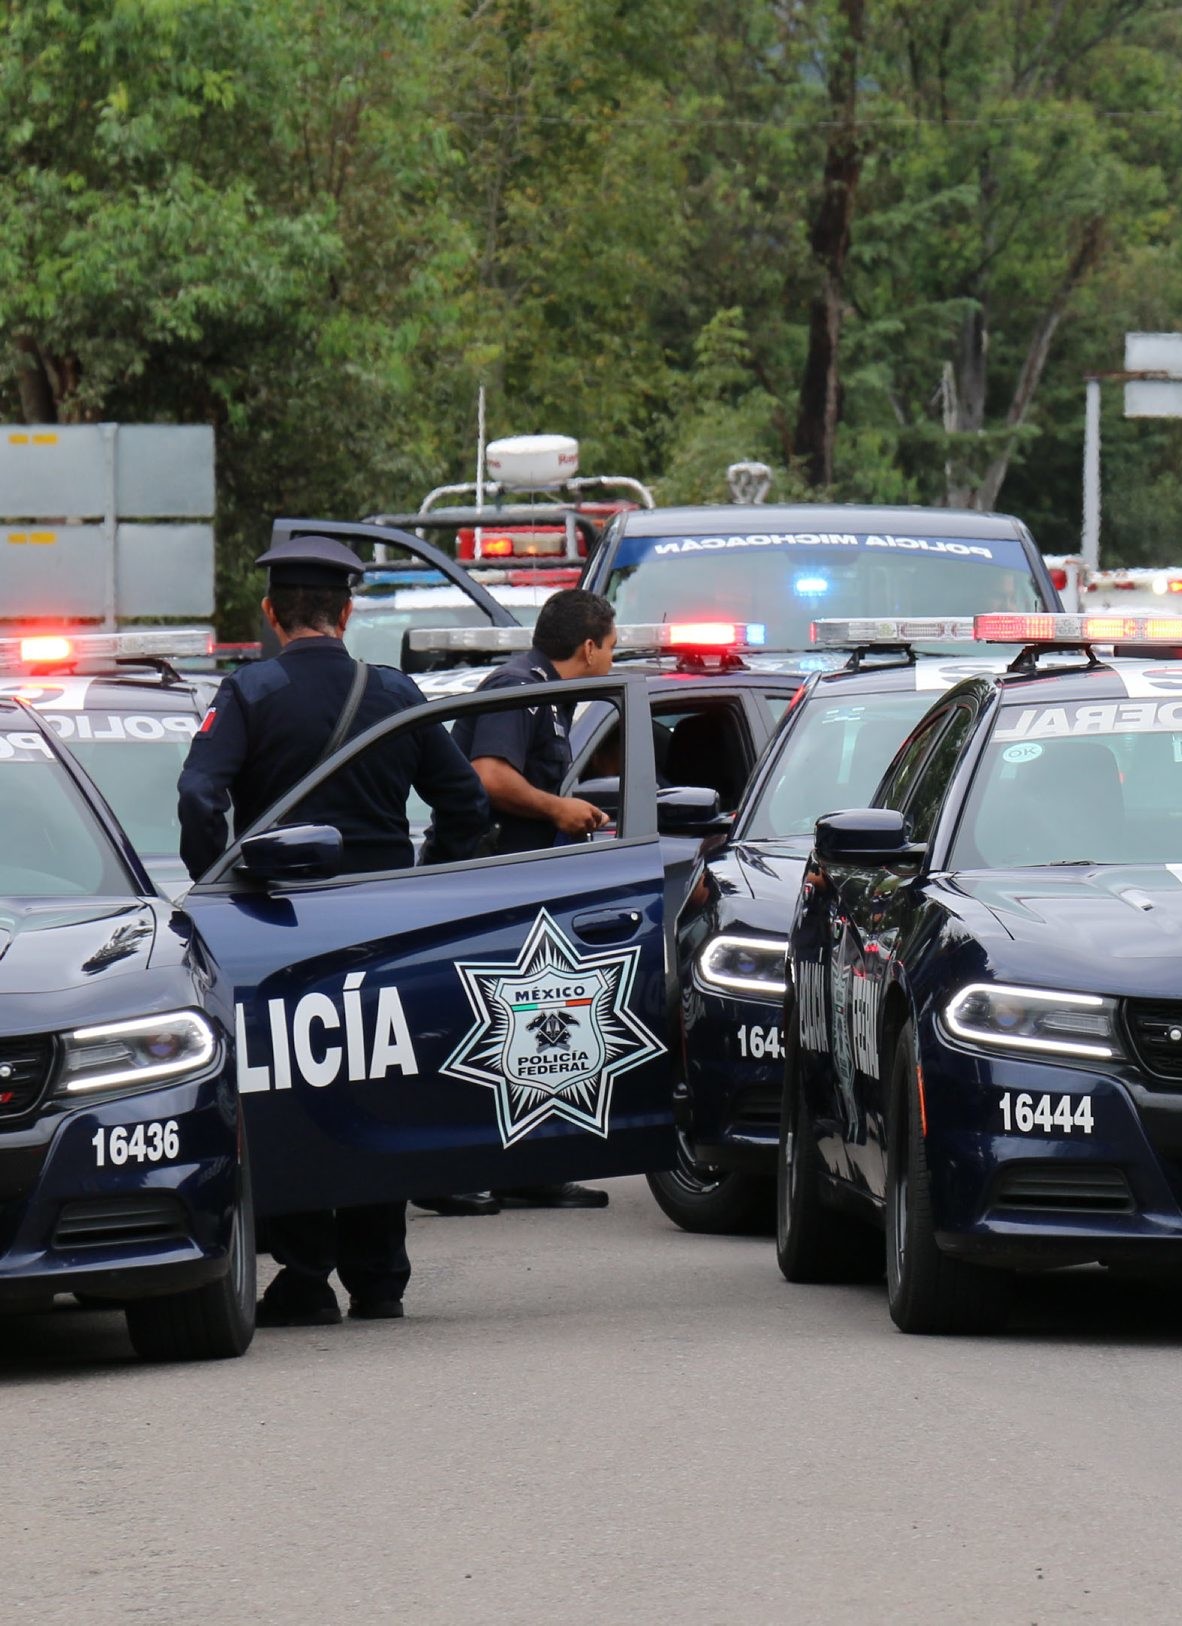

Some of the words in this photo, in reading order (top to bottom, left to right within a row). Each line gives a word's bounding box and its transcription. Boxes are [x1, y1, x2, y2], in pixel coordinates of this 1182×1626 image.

[515, 986, 585, 1002] MÉXICO
[235, 971, 419, 1094] LICÍA
[517, 1050, 589, 1066] POLICÍA
[518, 1062, 590, 1077] FEDERAL
[1000, 1092, 1094, 1134] 16444
[92, 1120, 180, 1167] 16436
